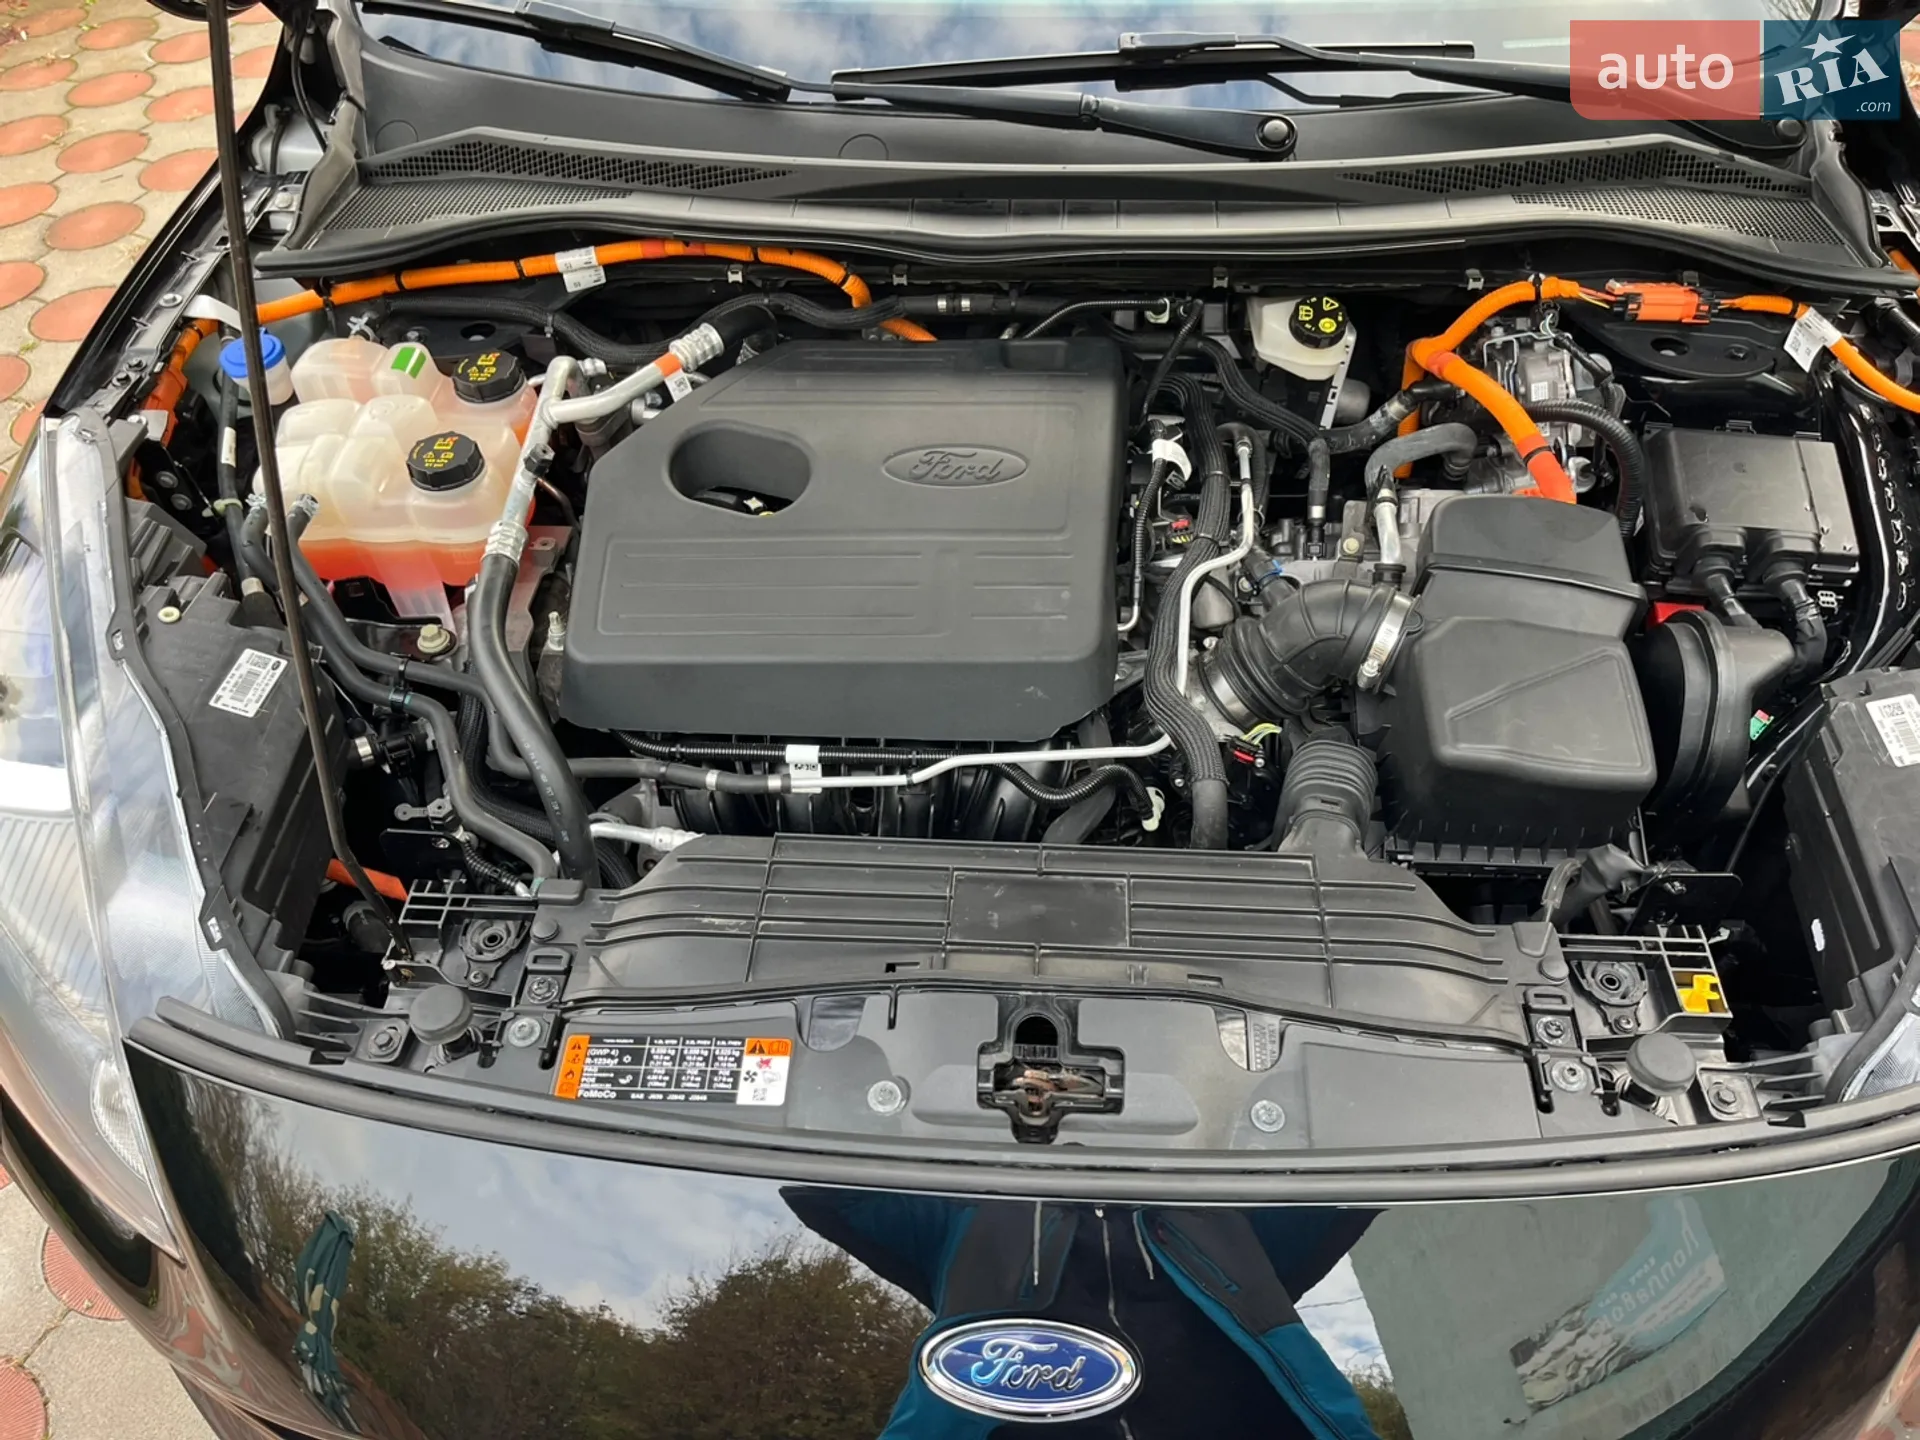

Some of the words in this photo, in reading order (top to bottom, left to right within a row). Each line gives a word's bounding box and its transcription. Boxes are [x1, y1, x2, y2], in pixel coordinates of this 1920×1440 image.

[909, 450, 1004, 481] Ford
[585, 1057, 619, 1066] R-1234yf
[577, 1090, 617, 1098] FoMoCo
[971, 1337, 1087, 1392] Ford
